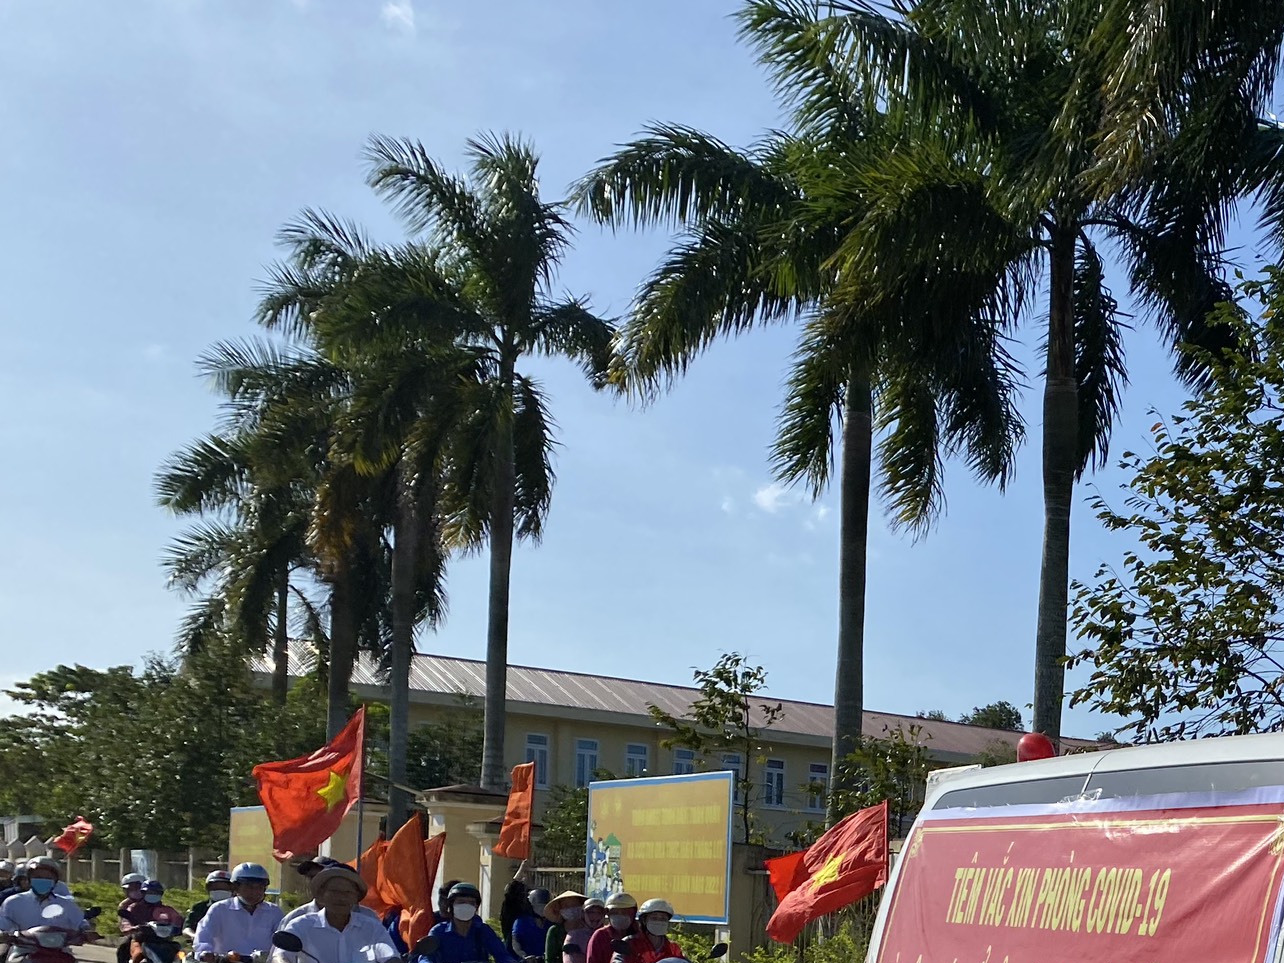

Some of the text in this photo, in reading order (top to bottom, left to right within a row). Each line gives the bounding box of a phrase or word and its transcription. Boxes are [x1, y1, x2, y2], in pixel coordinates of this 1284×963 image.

[945, 841, 1172, 937] TIÊM VẮC XIN PHÒNG COVID-19
